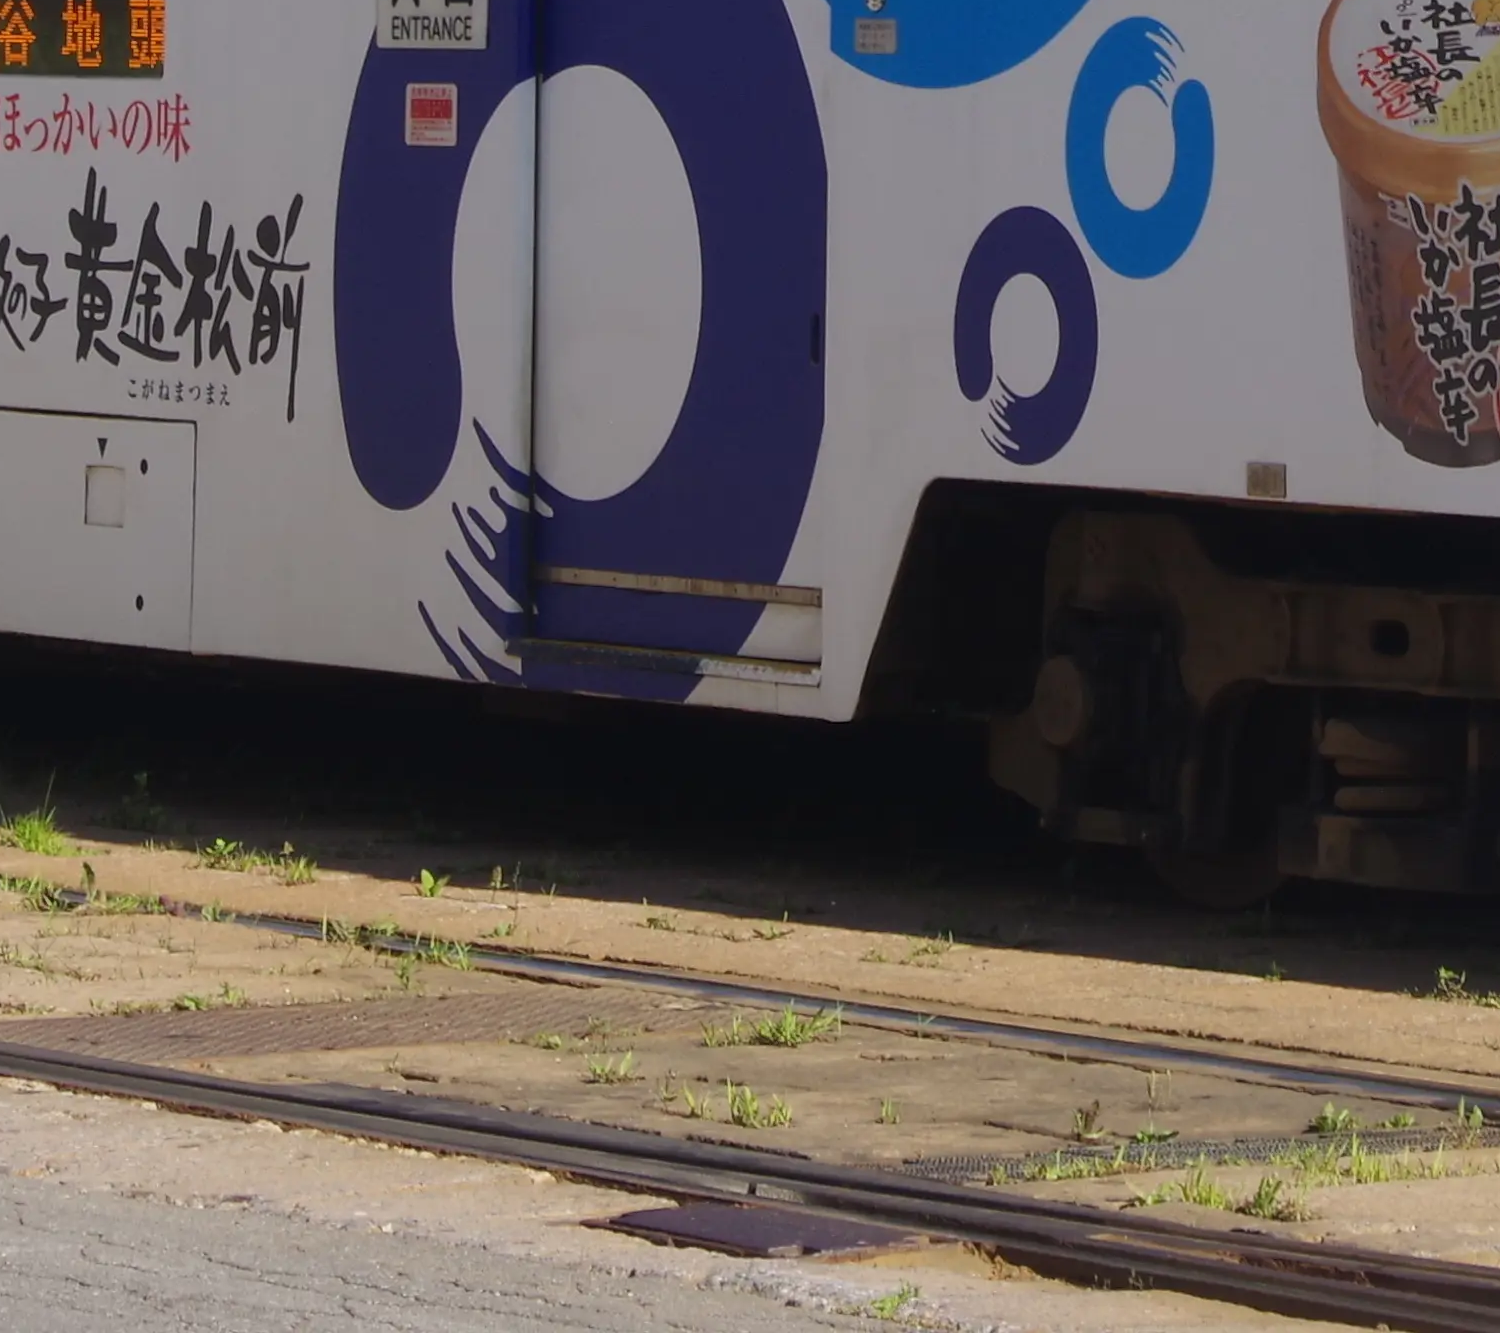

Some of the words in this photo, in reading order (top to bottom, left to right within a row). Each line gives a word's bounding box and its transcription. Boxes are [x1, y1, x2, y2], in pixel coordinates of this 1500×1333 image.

[391, 15, 473, 42] ENTRANCE
[1407, 194, 1477, 442] いか塩辛
[126, 379, 231, 407] こがねまつまえ
